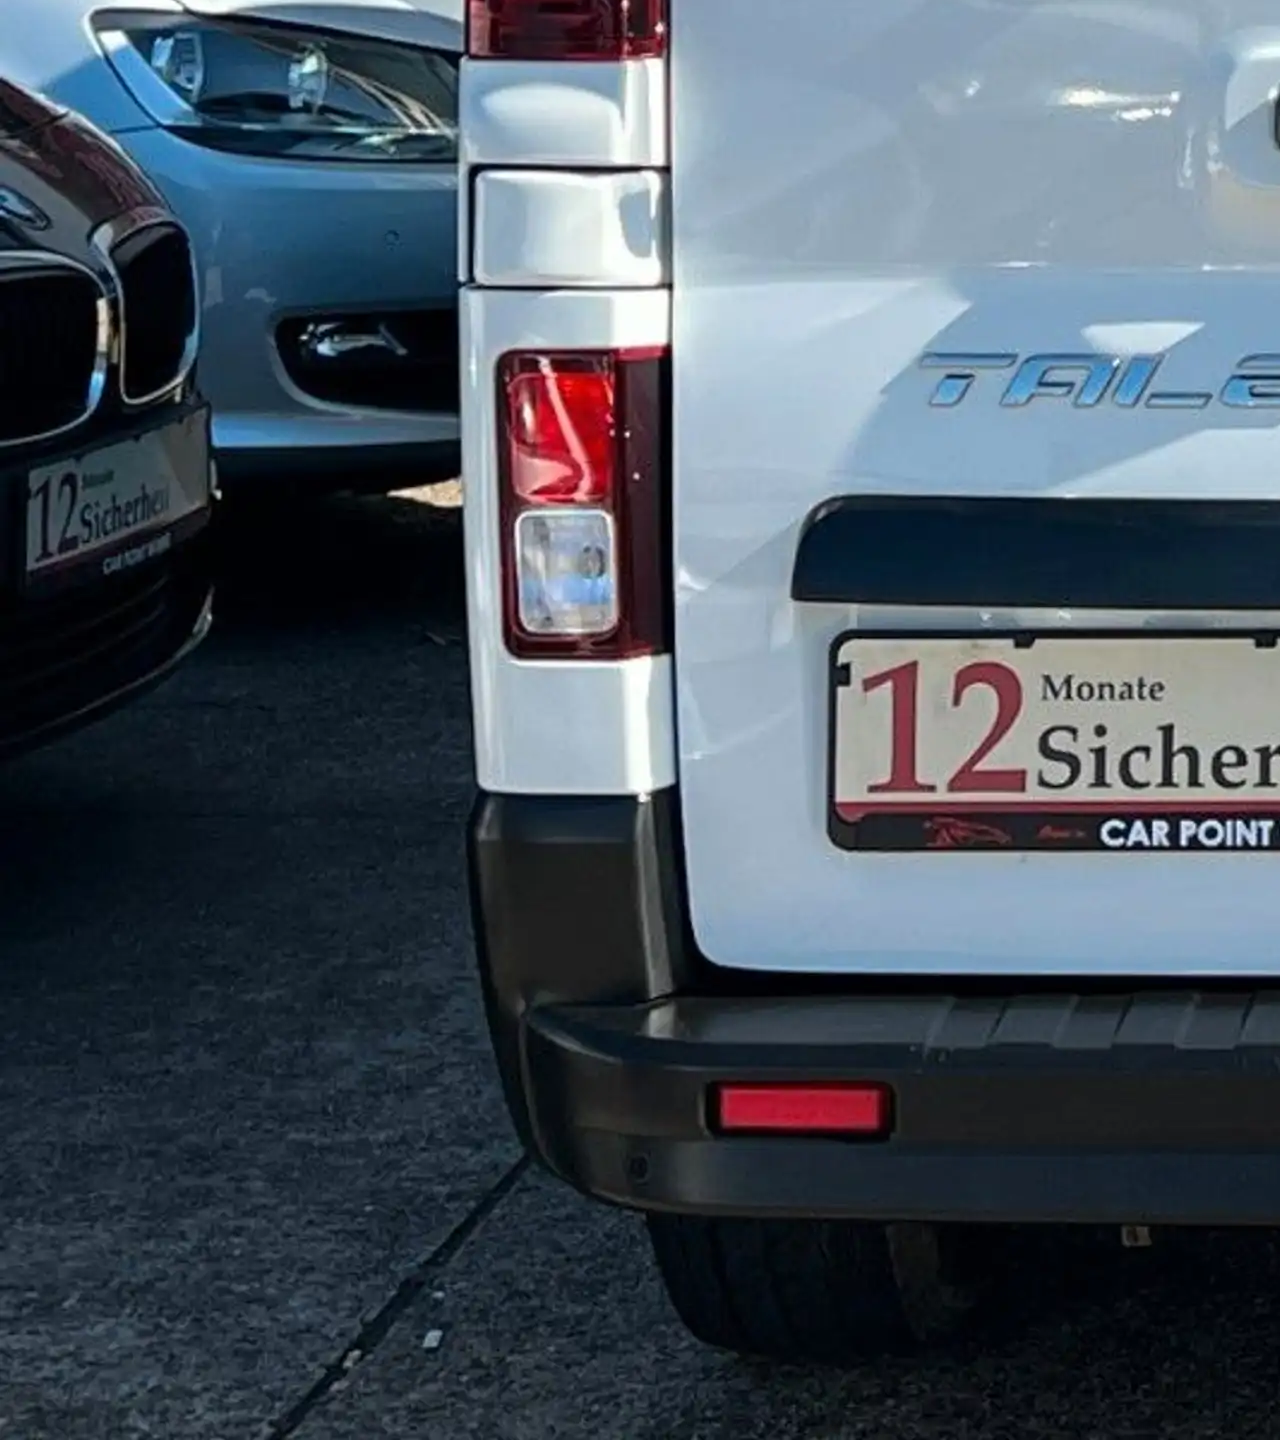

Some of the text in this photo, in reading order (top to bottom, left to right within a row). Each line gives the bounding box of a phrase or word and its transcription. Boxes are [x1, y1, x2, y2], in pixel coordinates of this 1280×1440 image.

[29, 471, 80, 563] 12
[1041, 674, 1165, 702] Monate
[861, 659, 1028, 794] 12
[1099, 819, 1170, 848] CAR
[1179, 818, 1275, 848] POINT
